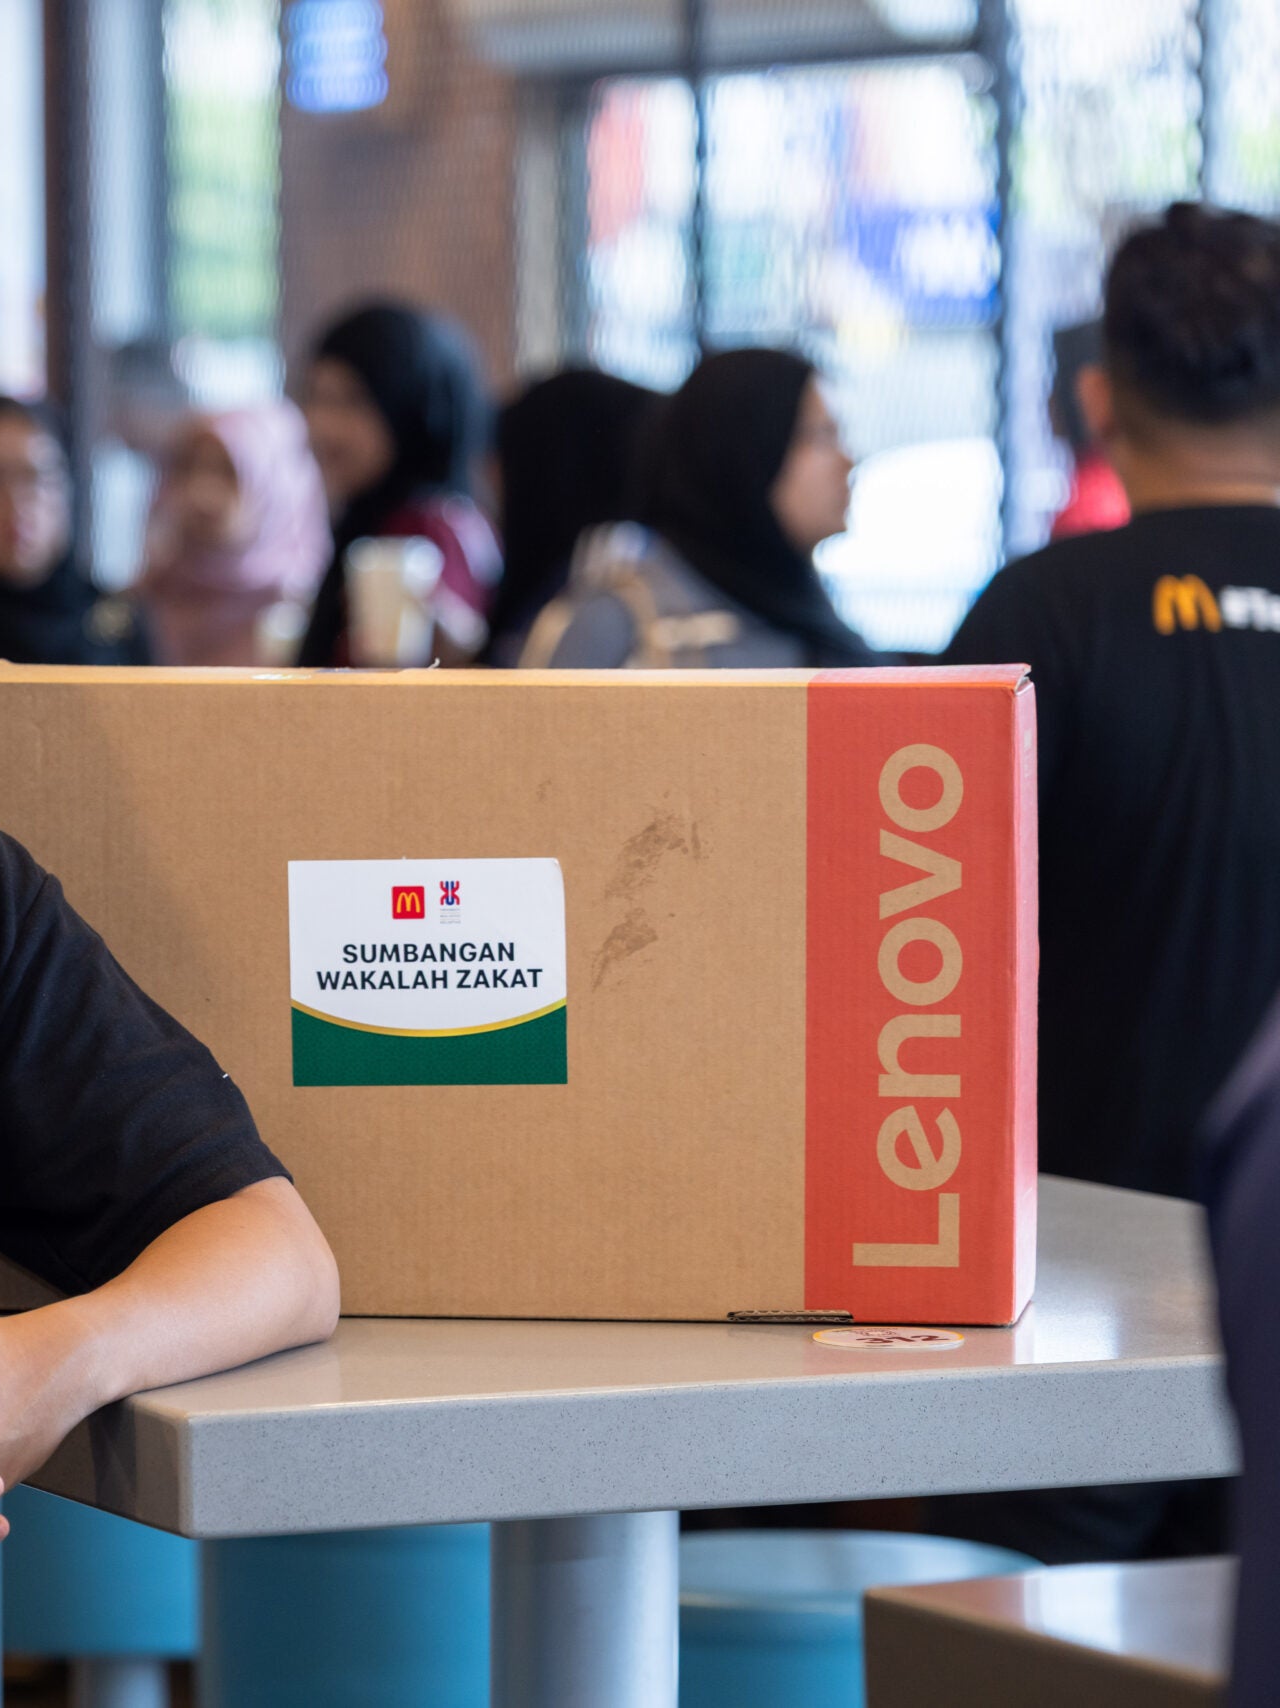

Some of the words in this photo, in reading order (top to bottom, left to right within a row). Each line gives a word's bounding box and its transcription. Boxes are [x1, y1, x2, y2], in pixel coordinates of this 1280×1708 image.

[342, 942, 515, 964] SUMBANGAN
[316, 969, 449, 990] WAKALAH
[456, 968, 543, 989] ZAKAT
[851, 743, 964, 1268] Lenovo
